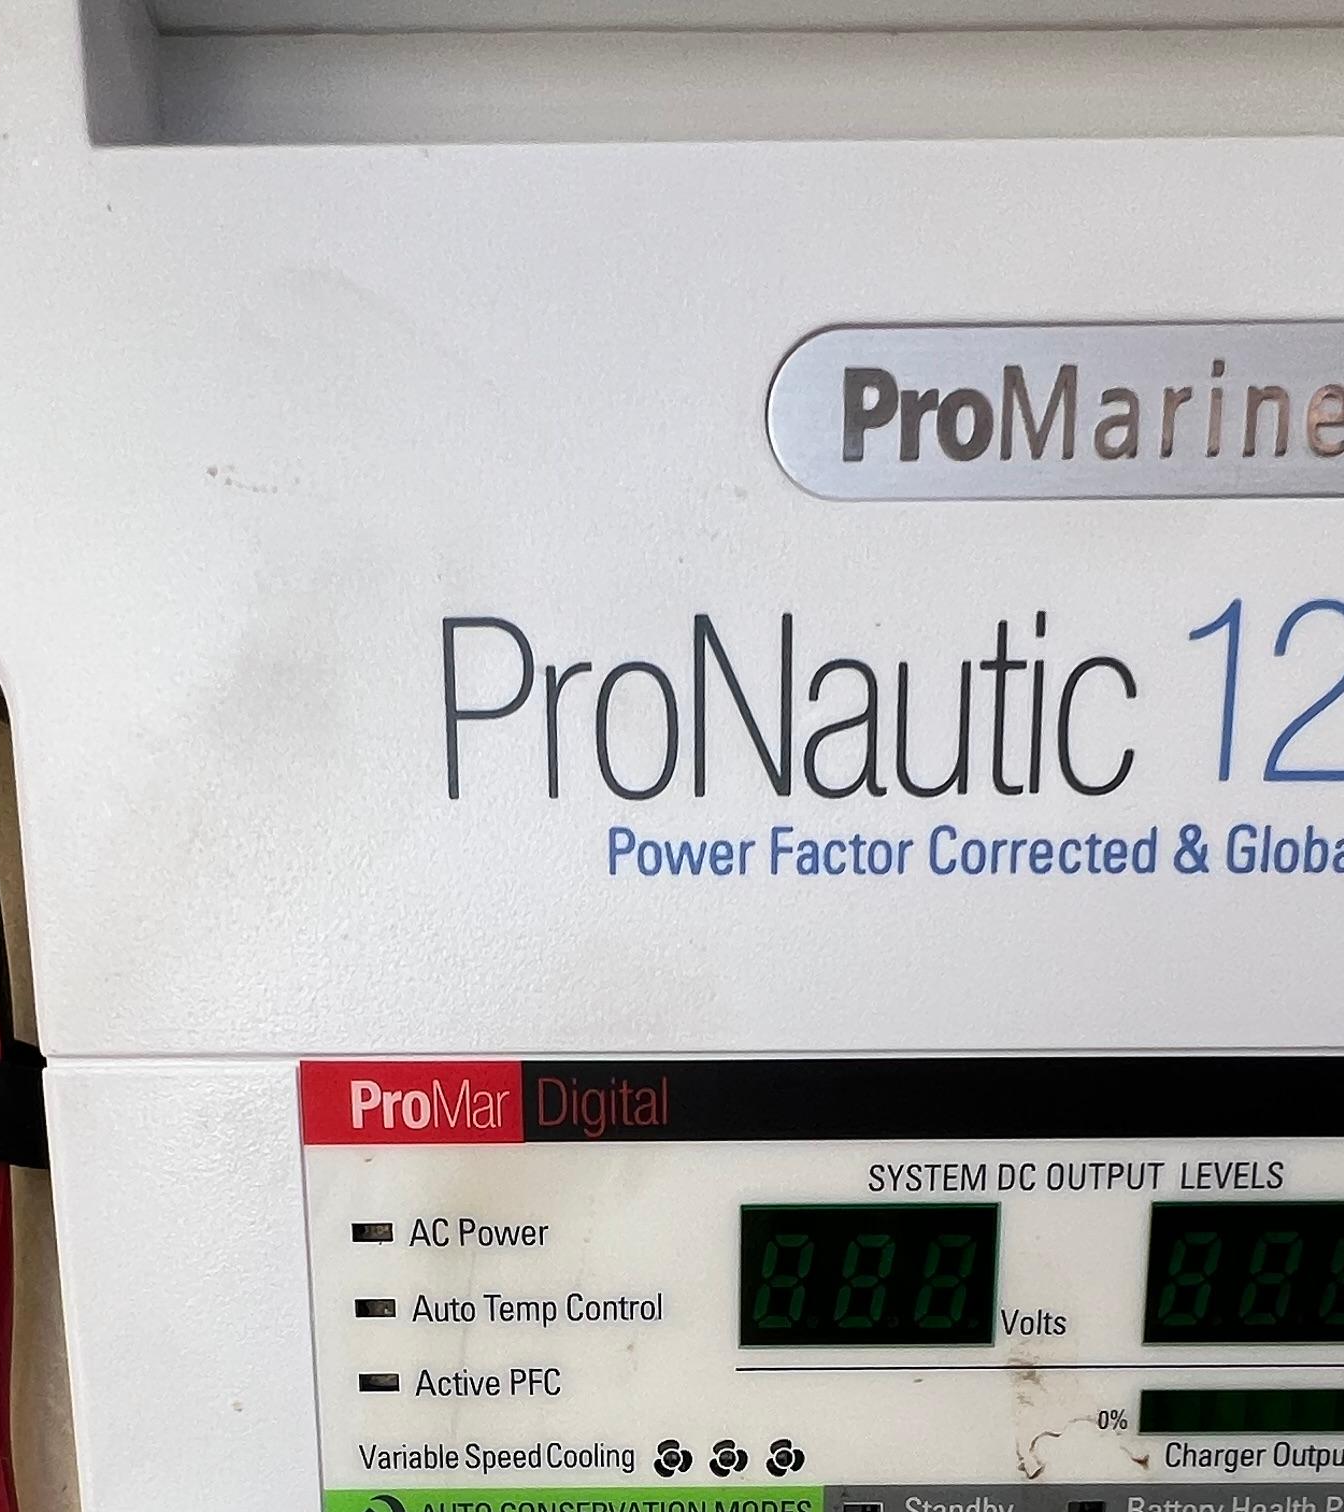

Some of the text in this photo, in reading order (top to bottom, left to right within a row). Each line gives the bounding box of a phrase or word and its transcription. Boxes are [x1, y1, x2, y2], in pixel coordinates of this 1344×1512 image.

[442, 610, 1138, 801] ProNautic
[608, 826, 756, 877] Power
[770, 826, 915, 876] Factor
[929, 824, 1158, 876] Corrected
[1173, 823, 1210, 875] &
[350, 1076, 671, 1139] ProMar Digital
[868, 1161, 1284, 1192] SYSTEM DC OUTPUT LEVELS
[408, 1217, 549, 1247] AC Power
[412, 1292, 662, 1329] Auto Temp Control
[1000, 1309, 1067, 1336] Volts
[415, 1367, 561, 1397] Active PFC
[1097, 1408, 1128, 1431] 0%
[358, 1442, 635, 1475] Variable Speed Cooling
[1165, 1441, 1267, 1474] Charger
